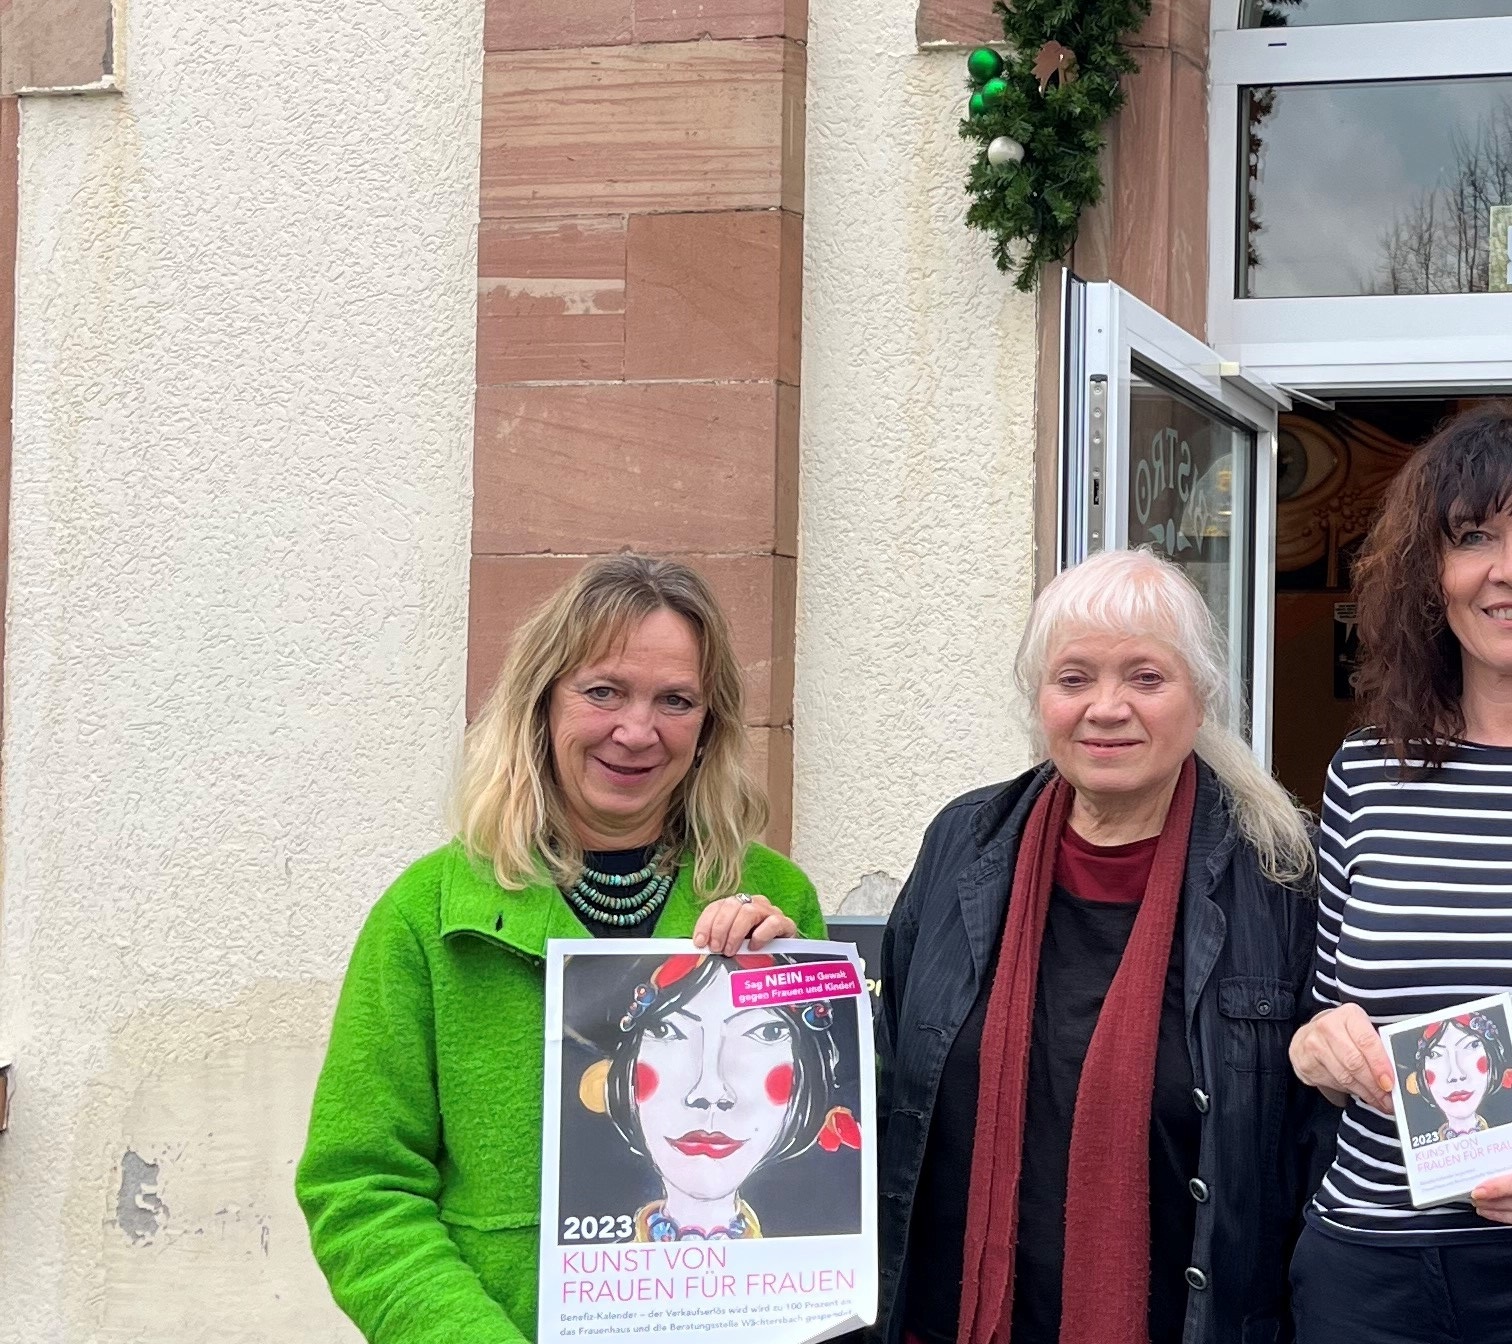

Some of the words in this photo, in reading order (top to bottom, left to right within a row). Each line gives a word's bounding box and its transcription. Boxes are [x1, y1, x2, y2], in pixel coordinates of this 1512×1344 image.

[744, 980, 763, 990] Sag
[765, 971, 802, 987] NEIN
[817, 970, 847, 981] Gewalt
[739, 993, 769, 1003] gegen
[772, 988, 804, 998] Frauen
[806, 985, 822, 993] und
[825, 981, 855, 992] Kinder!
[1412, 1131, 1439, 1147] 2023
[1416, 1145, 1450, 1161] KUNST
[1452, 1136, 1478, 1151] VON
[1417, 1155, 1461, 1172] FRAUEN
[563, 1215, 633, 1239] 2023
[563, 1249, 656, 1274] KUNST
[664, 1246, 726, 1269] VON
[563, 1277, 674, 1303] FRAUEN
[686, 1270, 736, 1298] FÜR
[746, 1269, 854, 1296] FRAUEN
[560, 1310, 637, 1322] Benefiz-Kalender
[648, 1309, 663, 1318] der
[665, 1306, 726, 1317] Verkaufserlös
[729, 1305, 748, 1315] wird
[751, 1304, 770, 1313] wird
[786, 1302, 802, 1310] 100
[560, 1327, 575, 1336] das
[578, 1326, 631, 1335] Frauenhaus
[633, 1323, 650, 1333] und
[653, 1322, 667, 1331] die
[670, 1319, 739, 1331] Beratungsstelle
[742, 1314, 804, 1326] Wächtersbach
